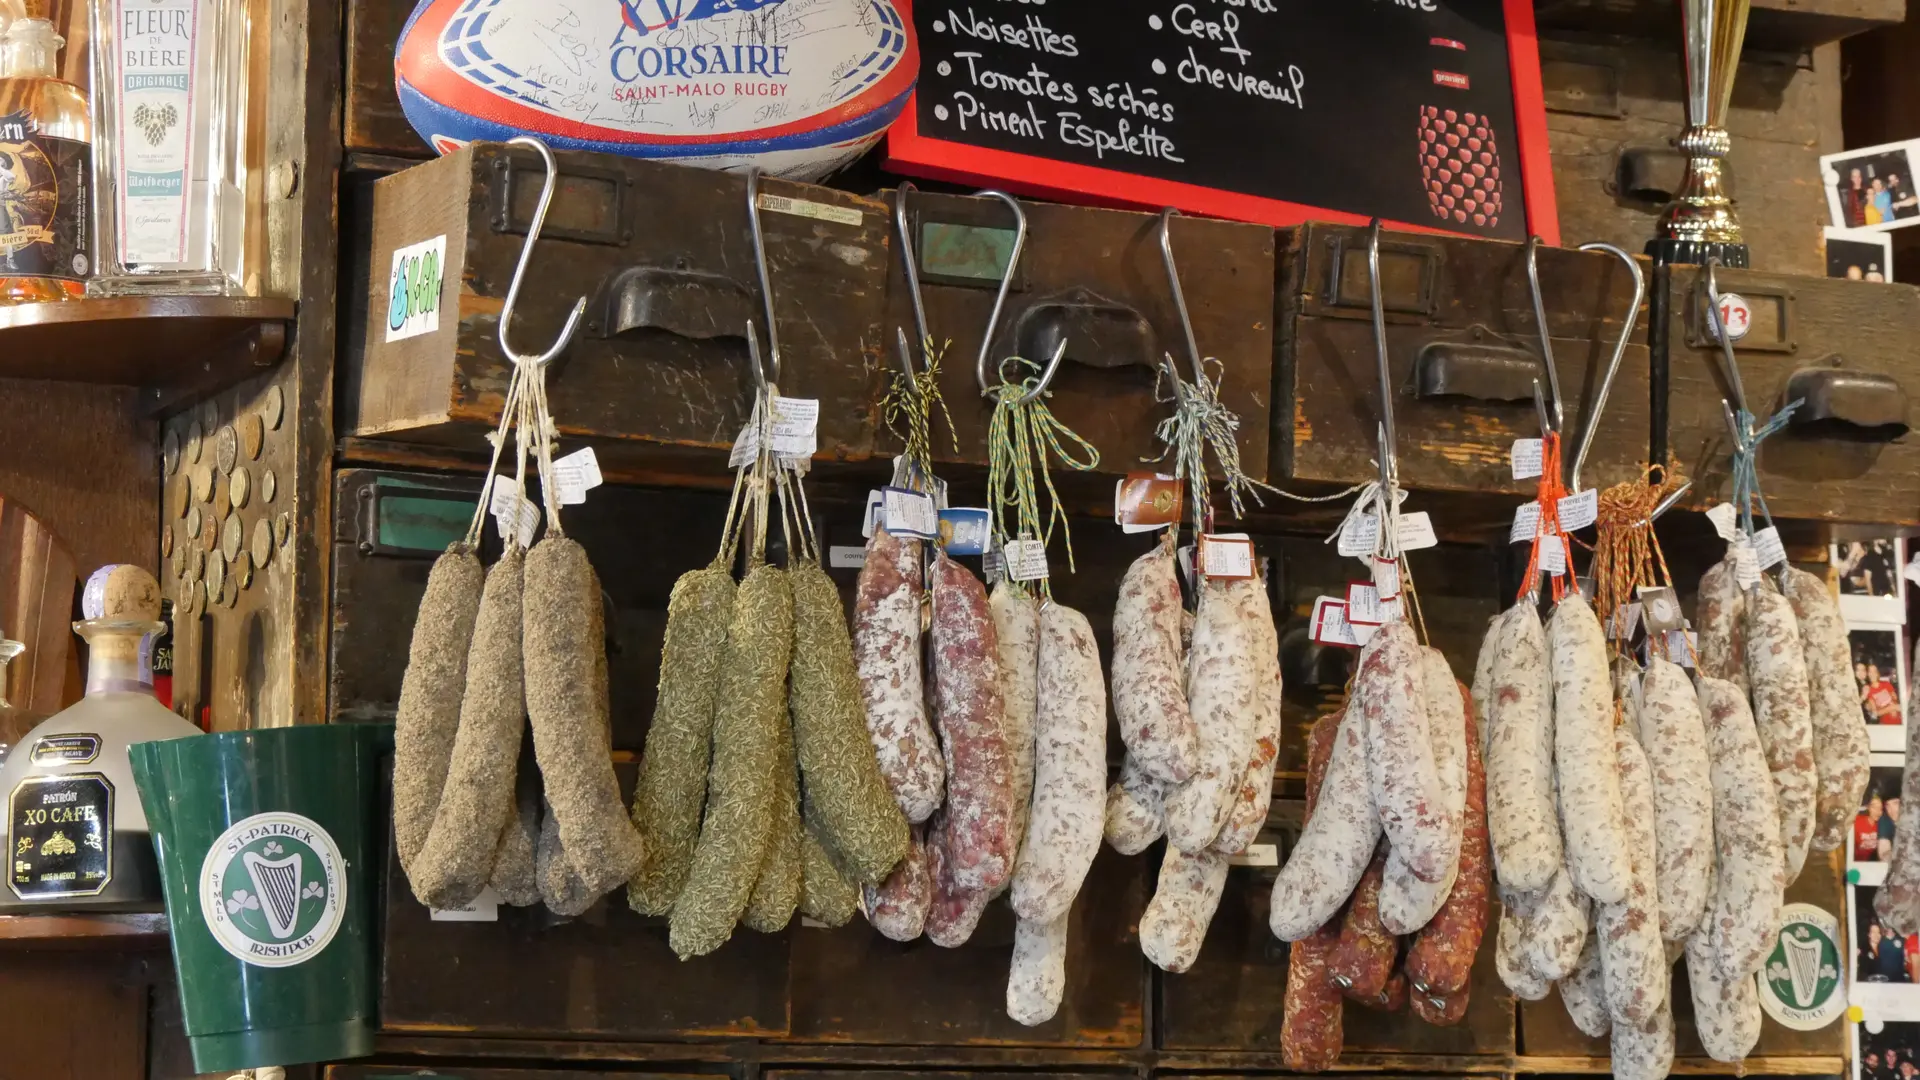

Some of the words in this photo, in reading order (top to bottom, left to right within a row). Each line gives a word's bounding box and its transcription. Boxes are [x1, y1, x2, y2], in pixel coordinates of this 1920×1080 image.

[124, 9, 190, 40] FLEUR
[948, 7, 1079, 56] Noisettes
[149, 36, 162, 45] DE
[125, 46, 187, 67] BIÈRE
[610, 45, 792, 83] CORSAIRE
[128, 75, 185, 88] ORIGINALE
[953, 51, 1078, 104] Tomates
[1435, 73, 1466, 85] granini
[615, 83, 726, 101] SAINT-MALO
[734, 83, 788, 97] RUGBY
[953, 91, 1047, 140] Piment
[1056, 112, 1185, 163] Espelette
[42, 790, 78, 805] PATRÓN
[24, 809, 47, 826] XO
[227, 823, 315, 855] ST-PATRICK
[250, 942, 288, 957] IRISH
[288, 934, 316, 955] PUB
